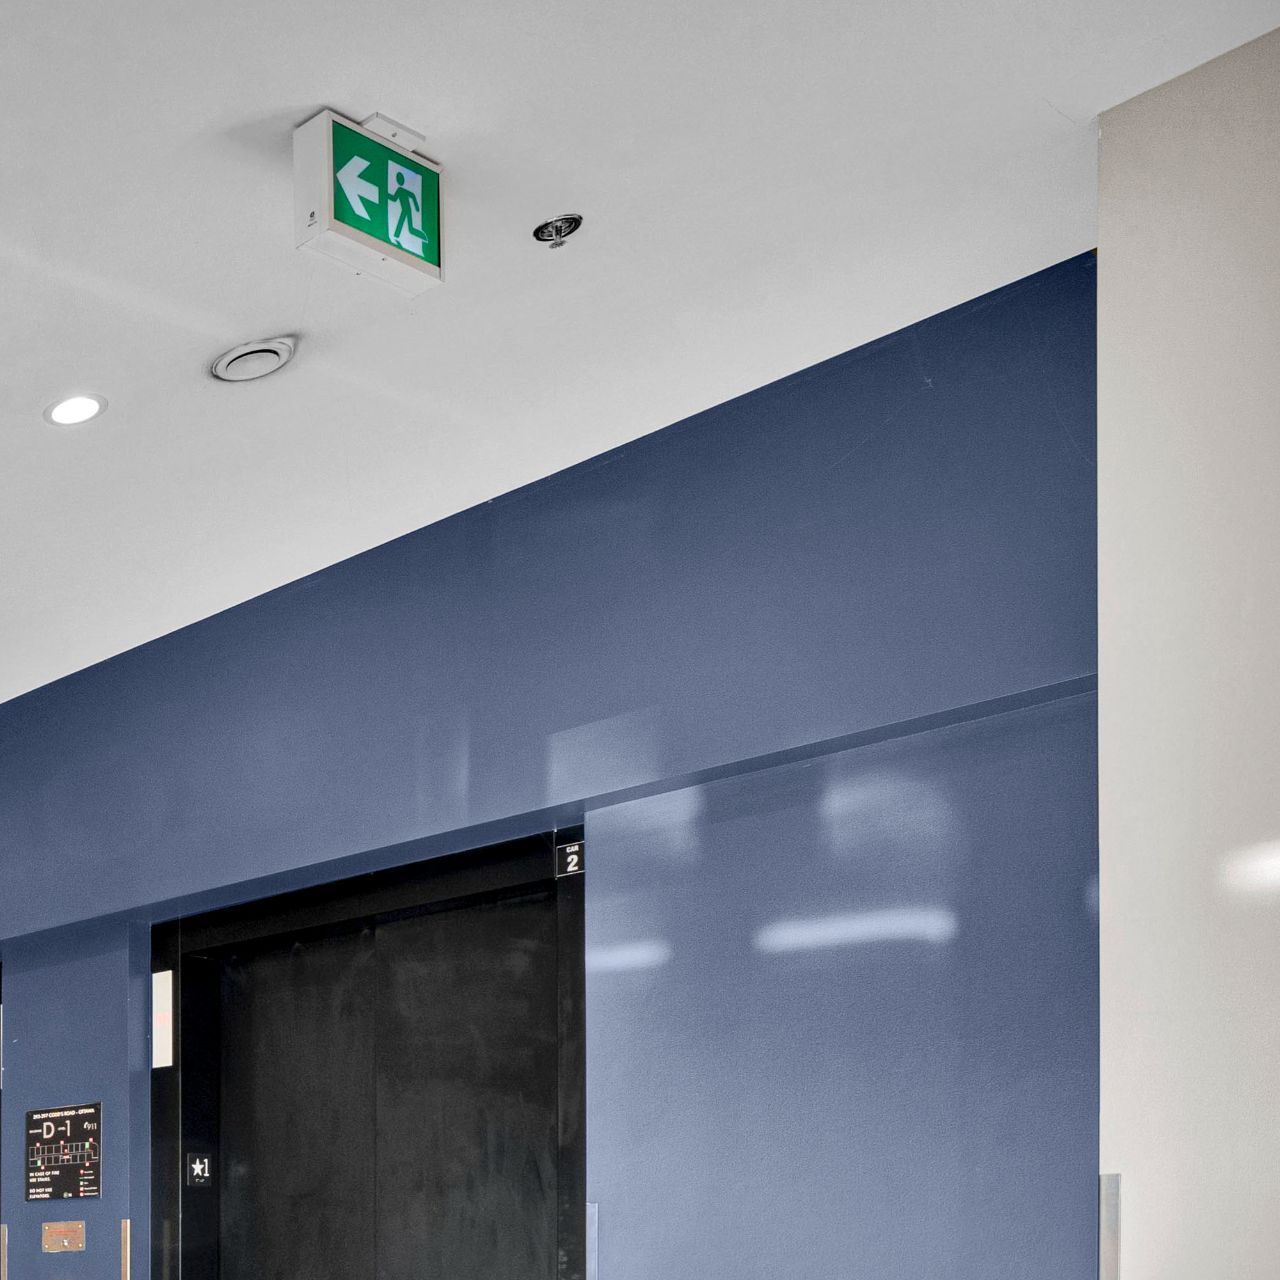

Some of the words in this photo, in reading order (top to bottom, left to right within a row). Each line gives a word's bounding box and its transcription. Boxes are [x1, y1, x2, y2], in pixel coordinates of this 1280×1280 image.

[566, 845, 579, 853] CAR
[566, 854, 579, 872] 2
[203, 1158, 210, 1177] 1
